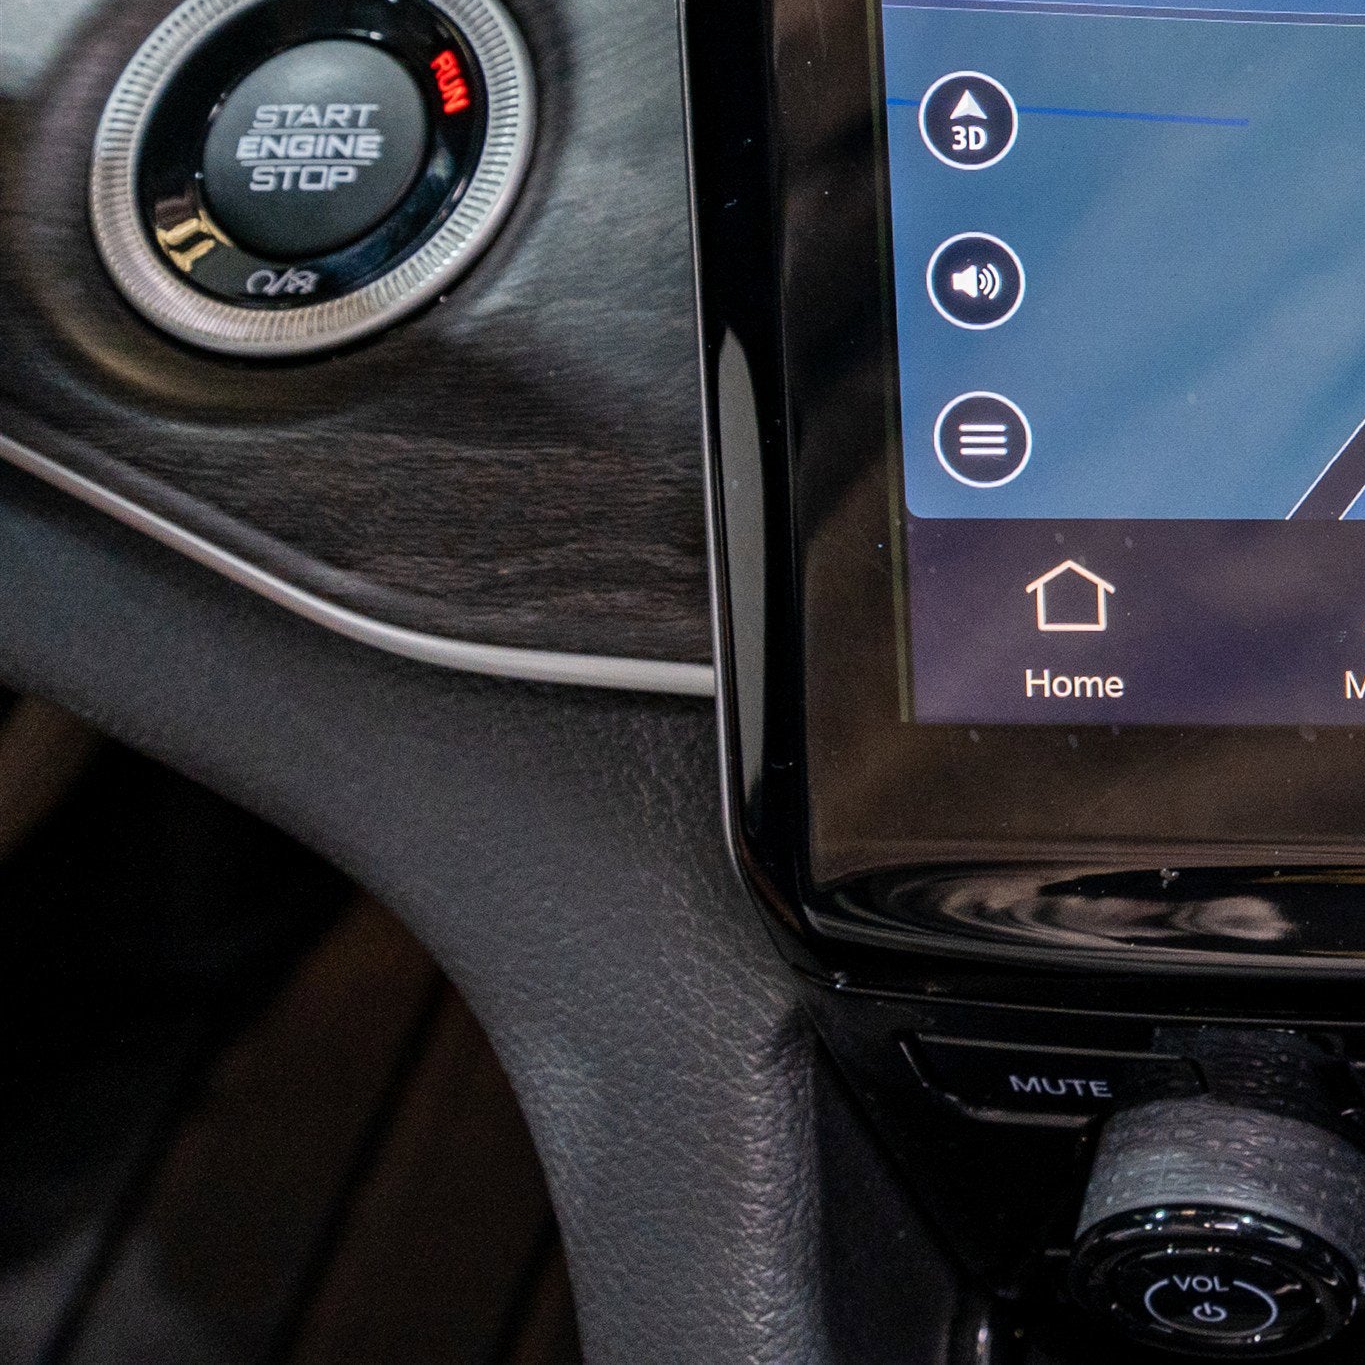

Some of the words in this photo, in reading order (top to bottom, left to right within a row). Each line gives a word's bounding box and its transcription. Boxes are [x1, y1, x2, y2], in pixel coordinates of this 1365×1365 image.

[430, 50, 470, 114] RUN
[252, 103, 378, 128] START
[236, 134, 382, 159] ENGINE
[951, 125, 987, 151] 3D
[249, 165, 357, 192] STOP
[1025, 668, 1124, 698] Home
[1009, 1075, 1112, 1098] MUTE
[1172, 1275, 1229, 1292] VOL
